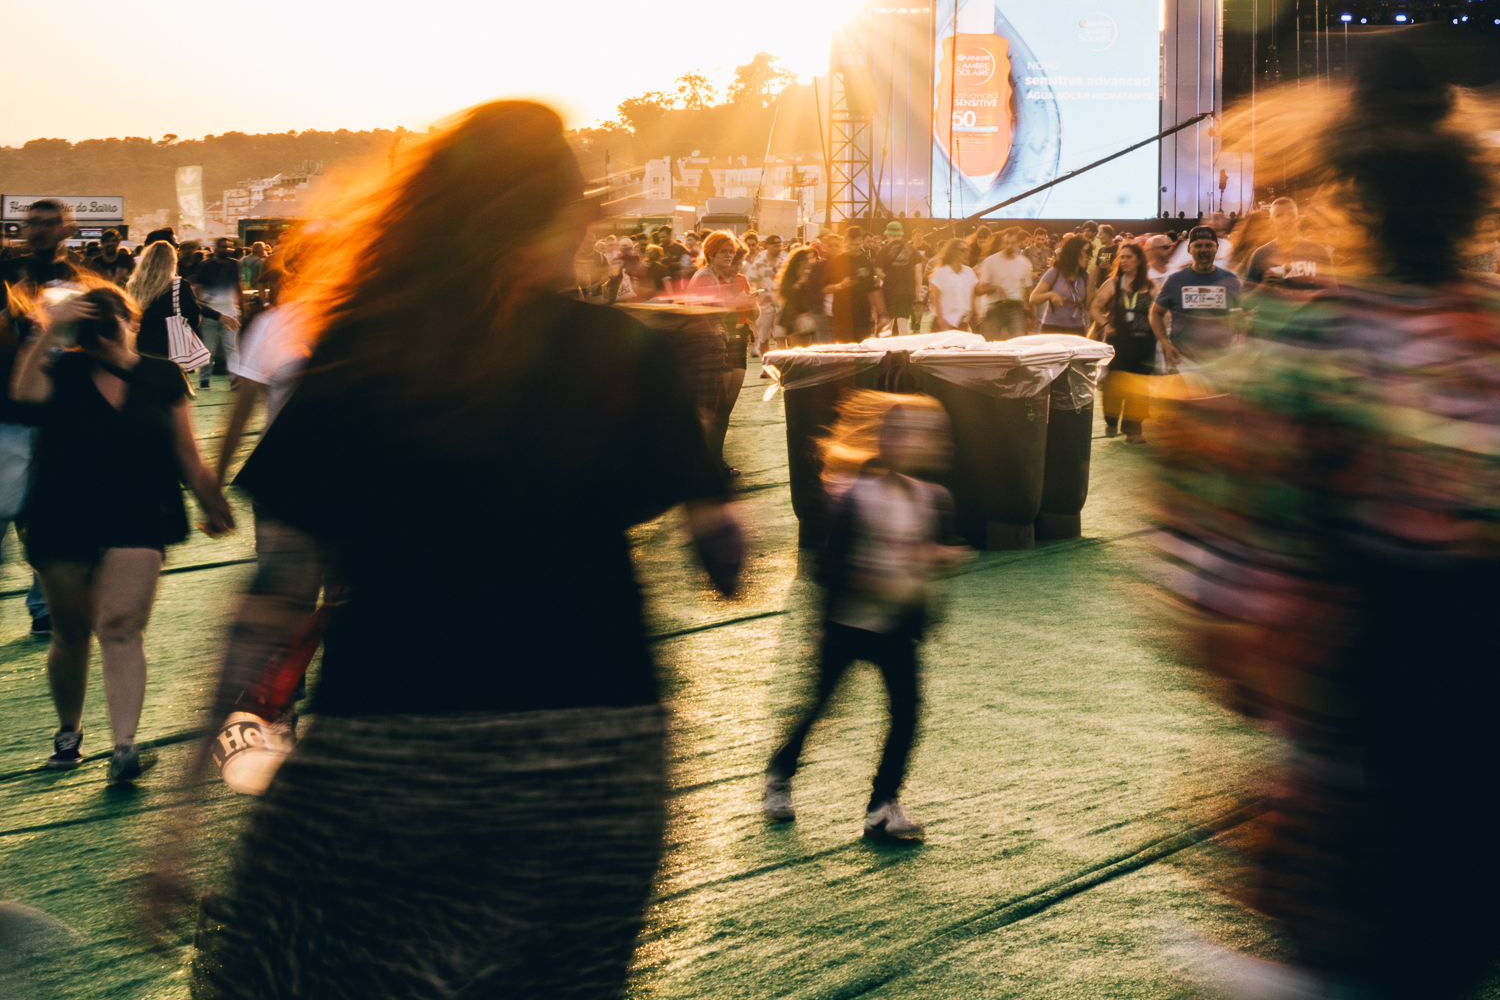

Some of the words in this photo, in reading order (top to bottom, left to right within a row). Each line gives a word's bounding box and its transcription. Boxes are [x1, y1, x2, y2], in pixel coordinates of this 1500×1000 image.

[957, 53, 990, 62] GARNIER
[1027, 61, 1059, 70] NOVO
[956, 67, 990, 76] SOLAIRE
[1025, 75, 1082, 86] sensitive
[1086, 75, 1151, 86] advanced
[1027, 90, 1054, 99] ÁGUA
[1057, 92, 1089, 100] SOLAR
[954, 99, 998, 107] SENSITIVE
[952, 111, 976, 127] 50
